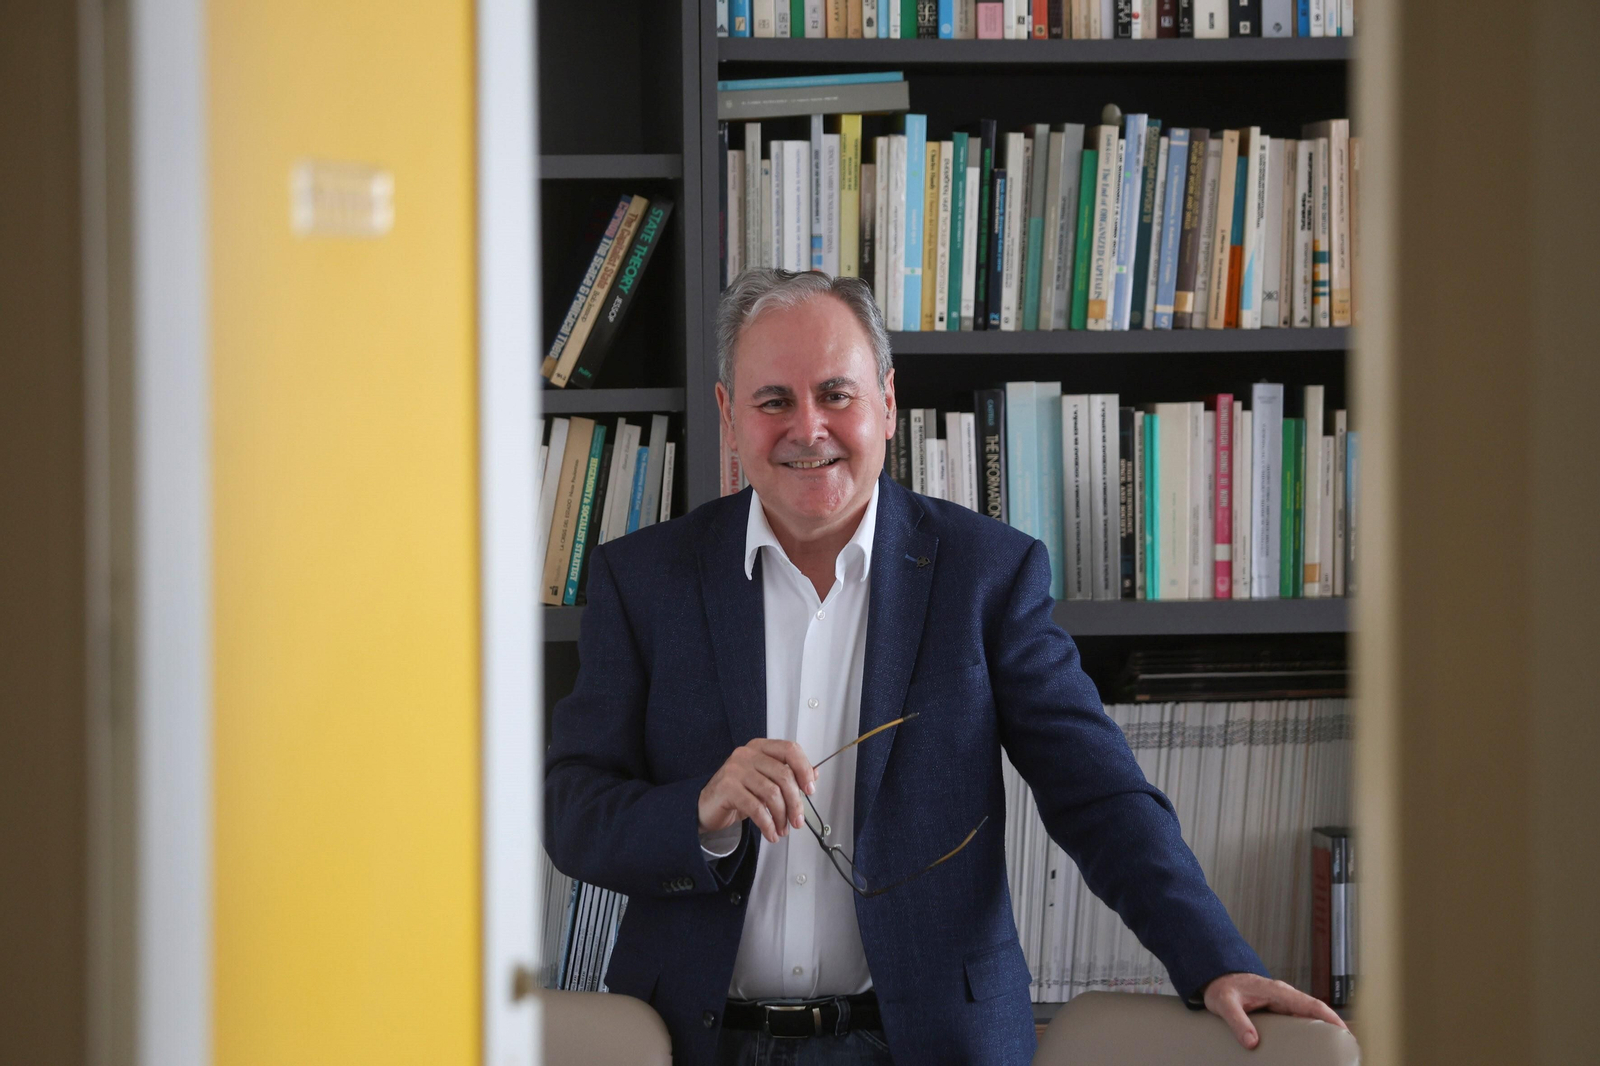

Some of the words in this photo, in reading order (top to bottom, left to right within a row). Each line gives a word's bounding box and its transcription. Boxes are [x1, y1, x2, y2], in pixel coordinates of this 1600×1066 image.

[1102, 169, 1111, 182] The
[1191, 165, 1197, 173] OF
[1100, 198, 1109, 206] of
[1101, 184, 1110, 197] End
[640, 207, 664, 242] STATE
[1096, 208, 1108, 255] ORGANIZED
[597, 237, 612, 256] The
[583, 255, 603, 286] State
[618, 244, 648, 293] THEORY
[560, 294, 585, 334] Political
[606, 296, 623, 322] JESSOP
[898, 418, 906, 447] Margaret
[1219, 397, 1229, 447] TECHNOLOGICAL
[986, 434, 999, 452] THE
[1220, 450, 1229, 474] CHANGE
[584, 458, 598, 498] HEGEMONY
[565, 498, 573, 518] ESTADO
[1220, 489, 1229, 507] WORK
[576, 505, 590, 542] SOCIALIST
[569, 544, 583, 581] STRATEGY
